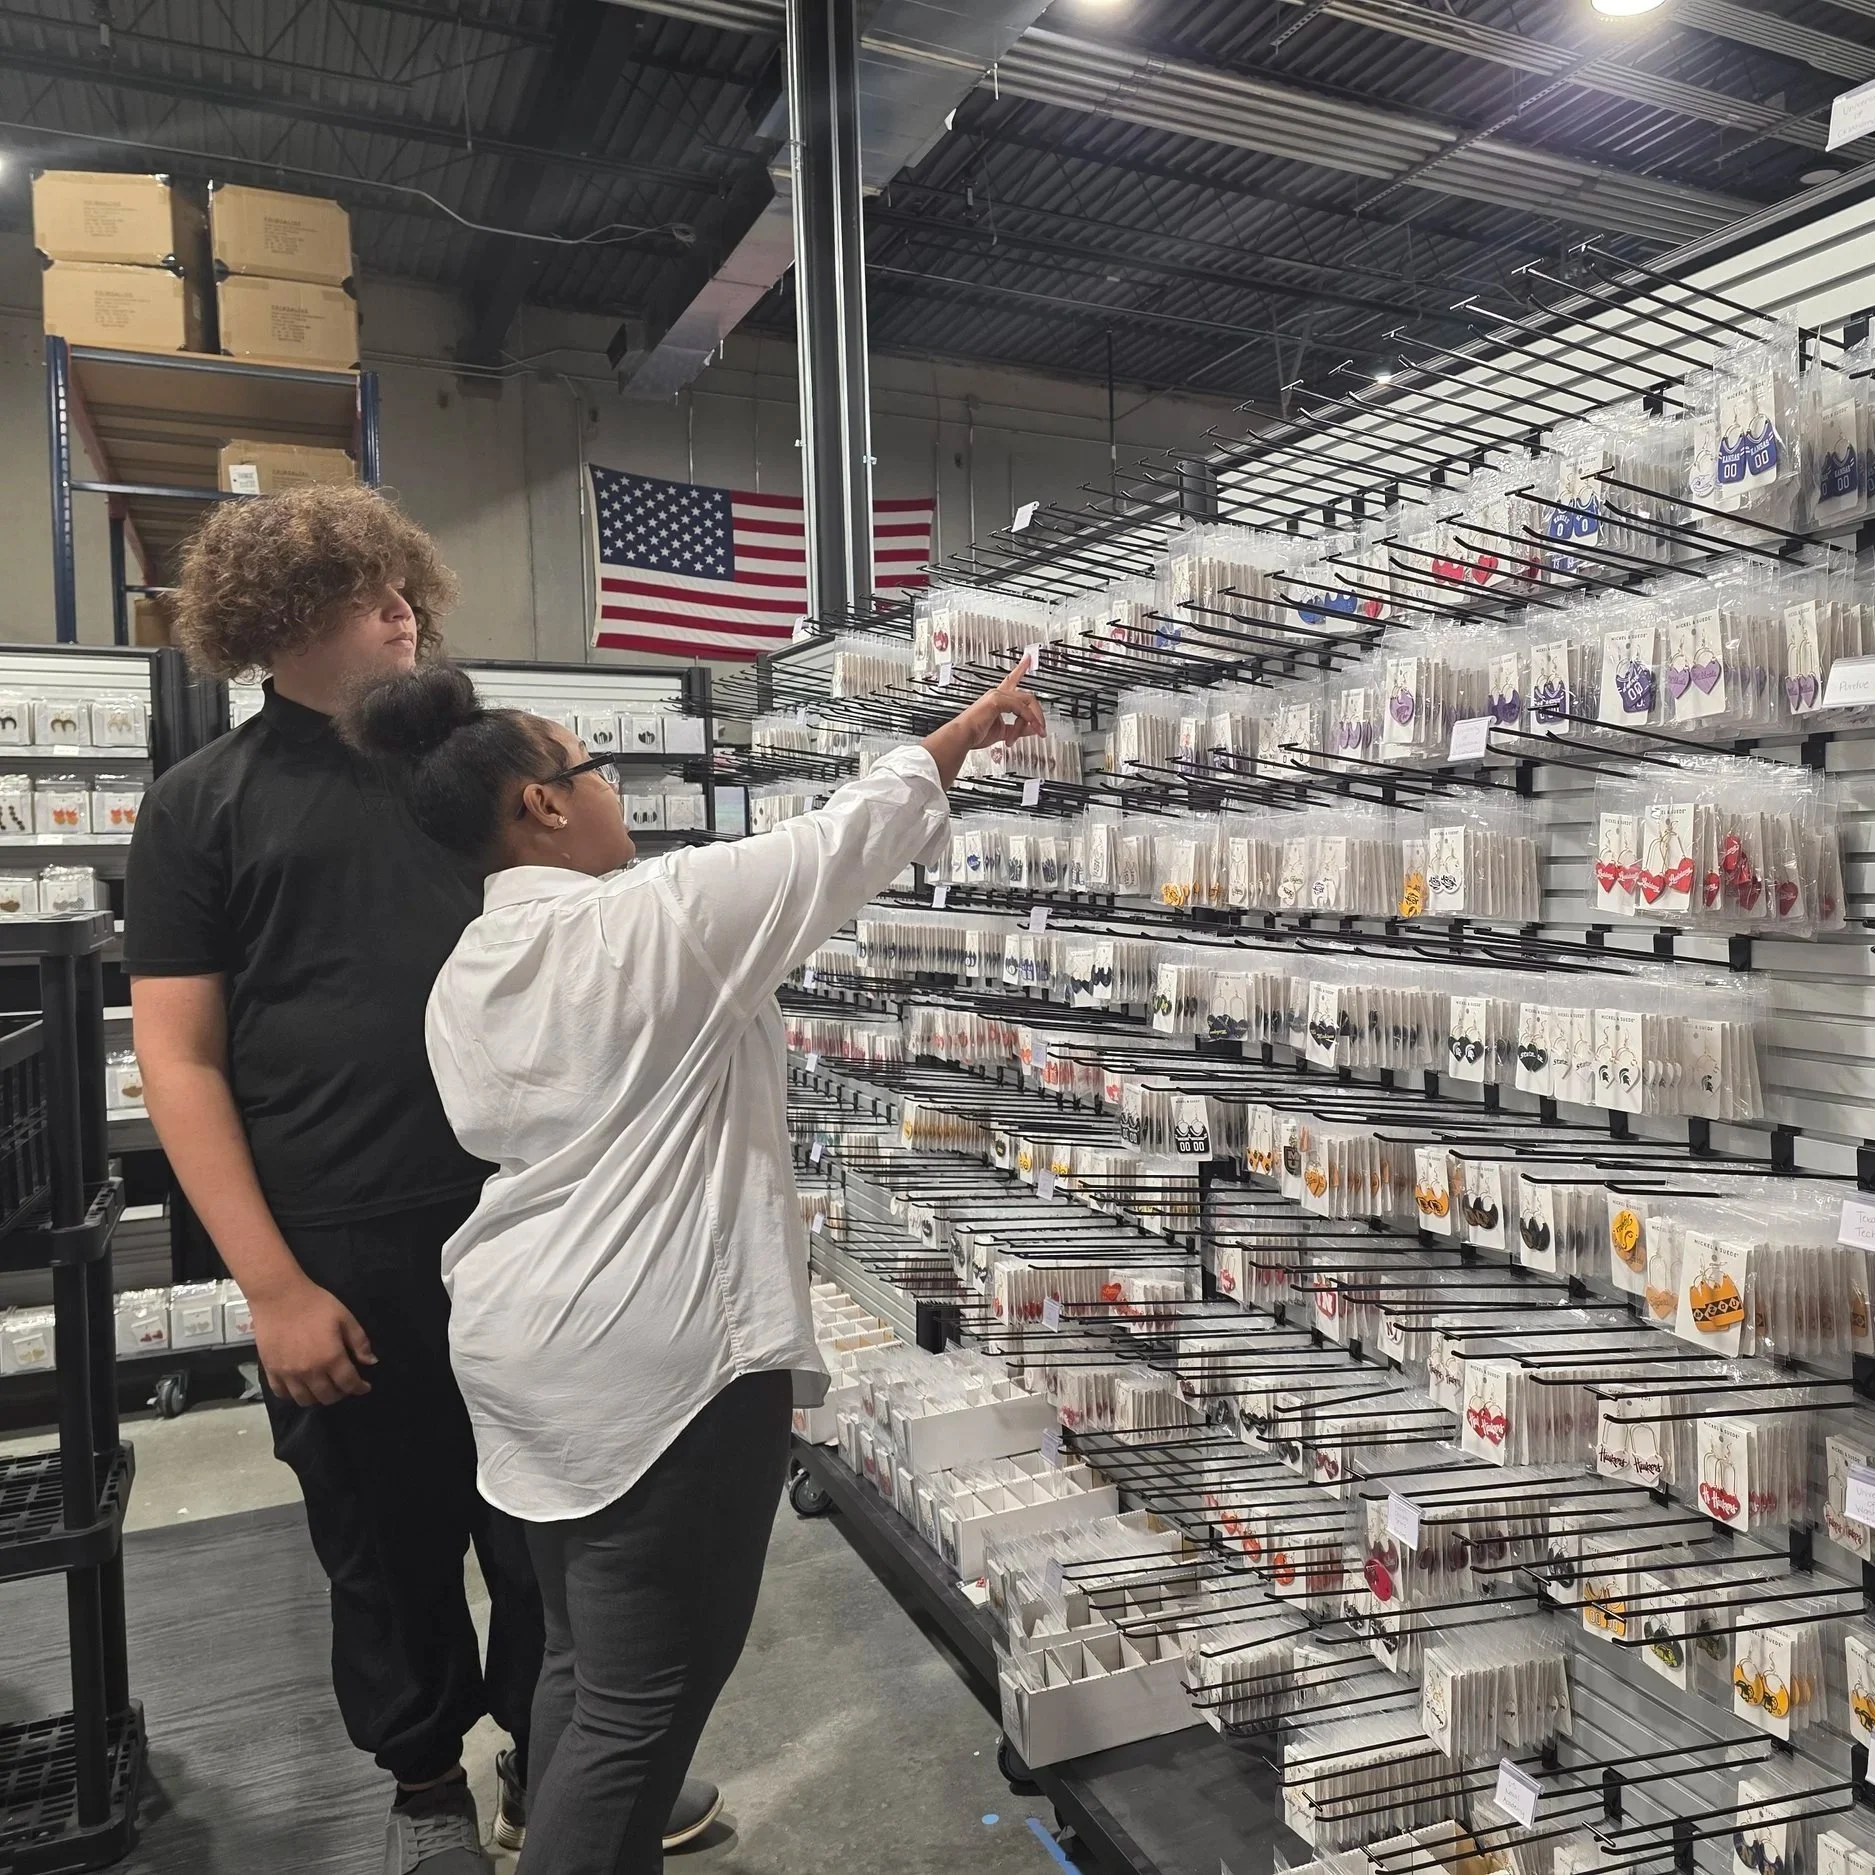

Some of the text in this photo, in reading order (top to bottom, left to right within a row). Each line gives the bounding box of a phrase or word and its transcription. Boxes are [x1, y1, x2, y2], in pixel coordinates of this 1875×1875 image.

[1750, 440, 1770, 456] KANSAS
[1755, 449, 1769, 468] 00
[1724, 463, 1737, 478] 00
[1180, 1141, 1191, 1152] 00
[1193, 1141, 1205, 1152] 00
[1599, 1446, 1628, 1468] Huskers
[1633, 1455, 1662, 1475] Huskers
